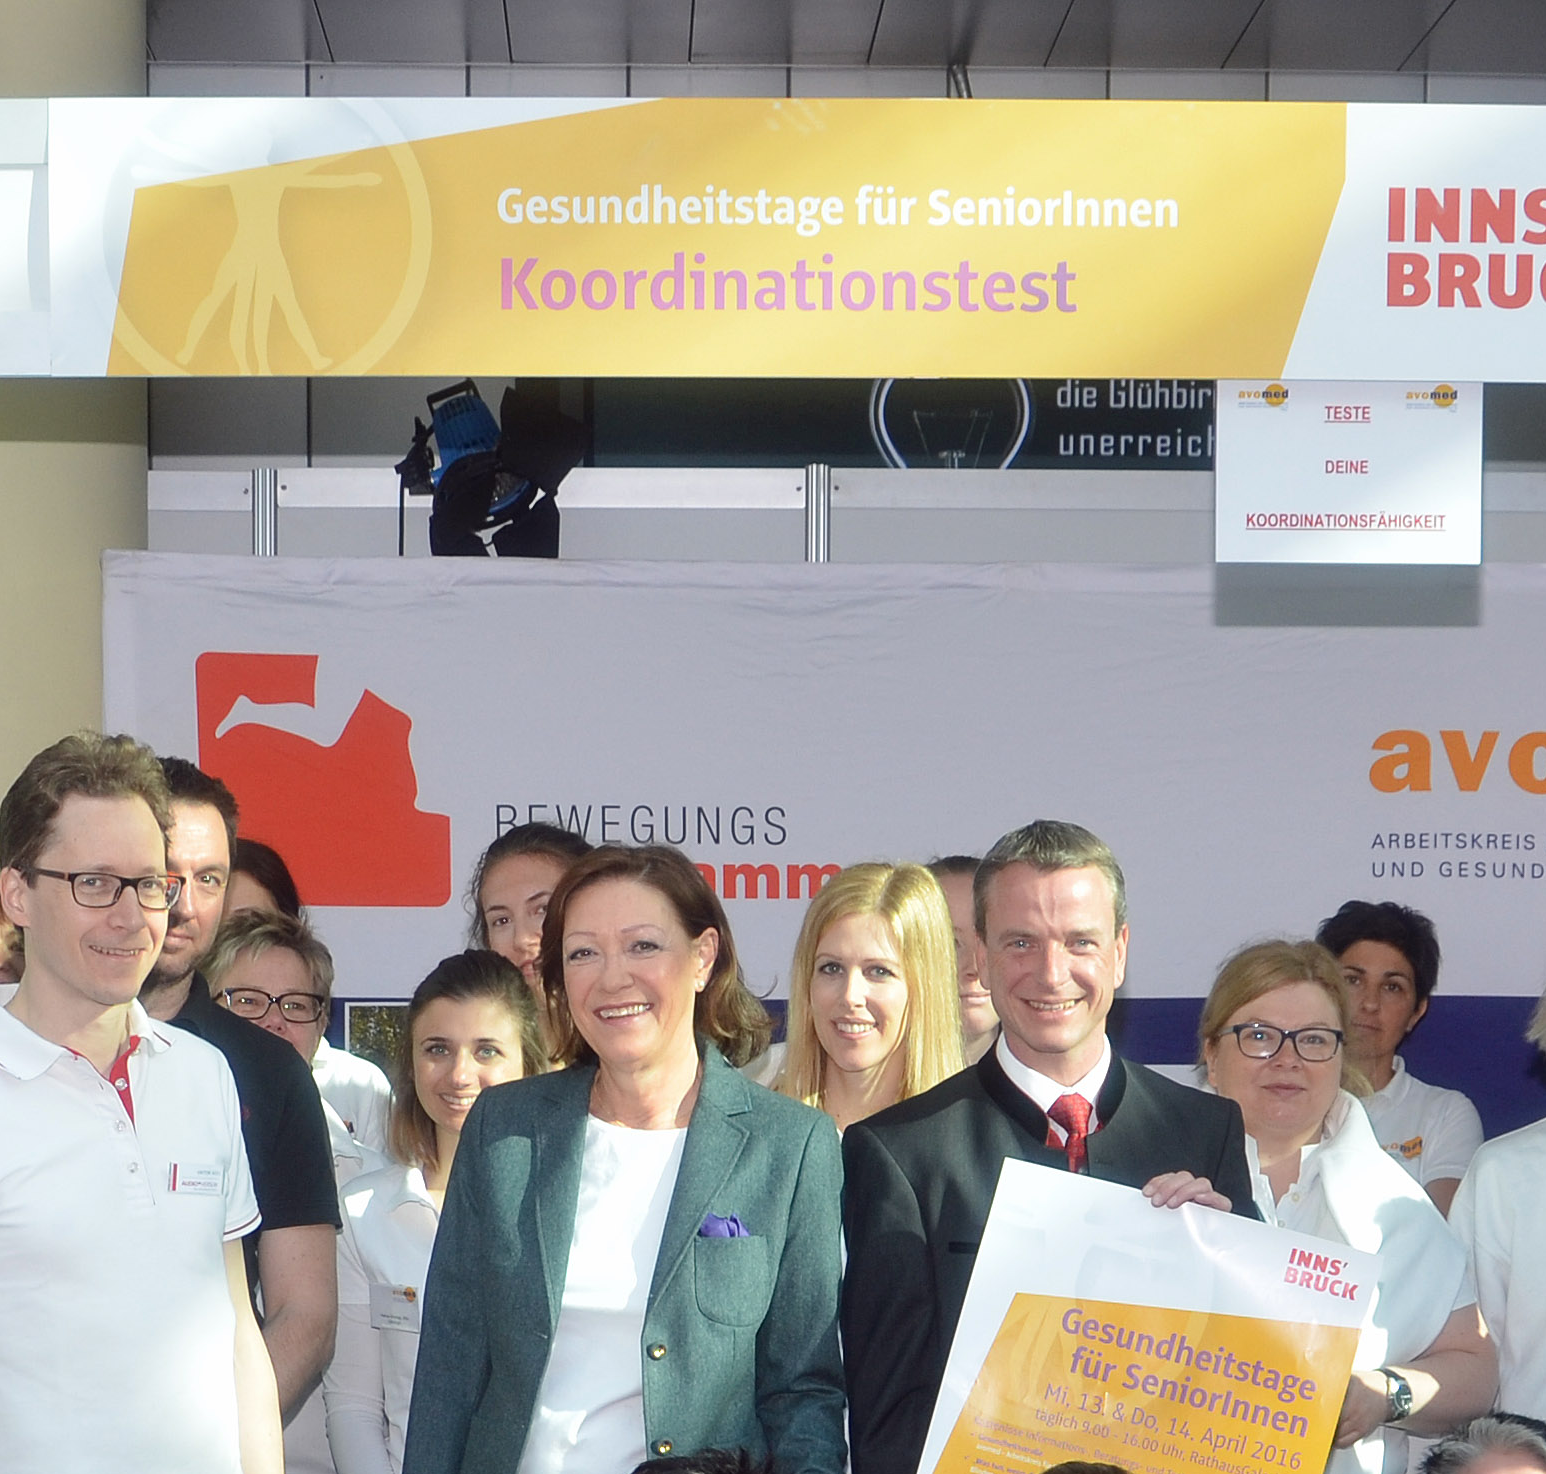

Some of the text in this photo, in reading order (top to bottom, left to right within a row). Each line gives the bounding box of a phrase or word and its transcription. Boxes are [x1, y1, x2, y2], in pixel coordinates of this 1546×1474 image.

[497, 184, 1179, 236] Gesundheitstage für SeniorInnen
[500, 252, 1078, 313] Koordinationstest
[1056, 379, 1214, 409] die Glühbir
[1238, 388, 1289, 399] avomed
[1406, 389, 1458, 400] avomed
[1324, 405, 1371, 421] TESTE
[1325, 460, 1369, 474] DEINE
[1246, 510, 1446, 530] KOORDINATIONSFÄHIGKEIT
[495, 803, 788, 847] BEWEGUNGS
[1370, 832, 1536, 850] ARBEITSKREIS
[1371, 861, 1425, 878] UND
[1284, 1265, 1359, 1301] BRUCK
[1061, 1307, 1318, 1404] Gesundheitstage
[1069, 1344, 1310, 1438] für SeniorInnen
[1035, 1407, 1079, 1430] täglich
[1081, 1419, 1111, 1440] 9.00
[1121, 1431, 1160, 1453] 16.00
[1161, 1441, 1186, 1462] Uhr,
[1043, 1381, 1303, 1471] Mi, 13. & Do, 14. April 2016
